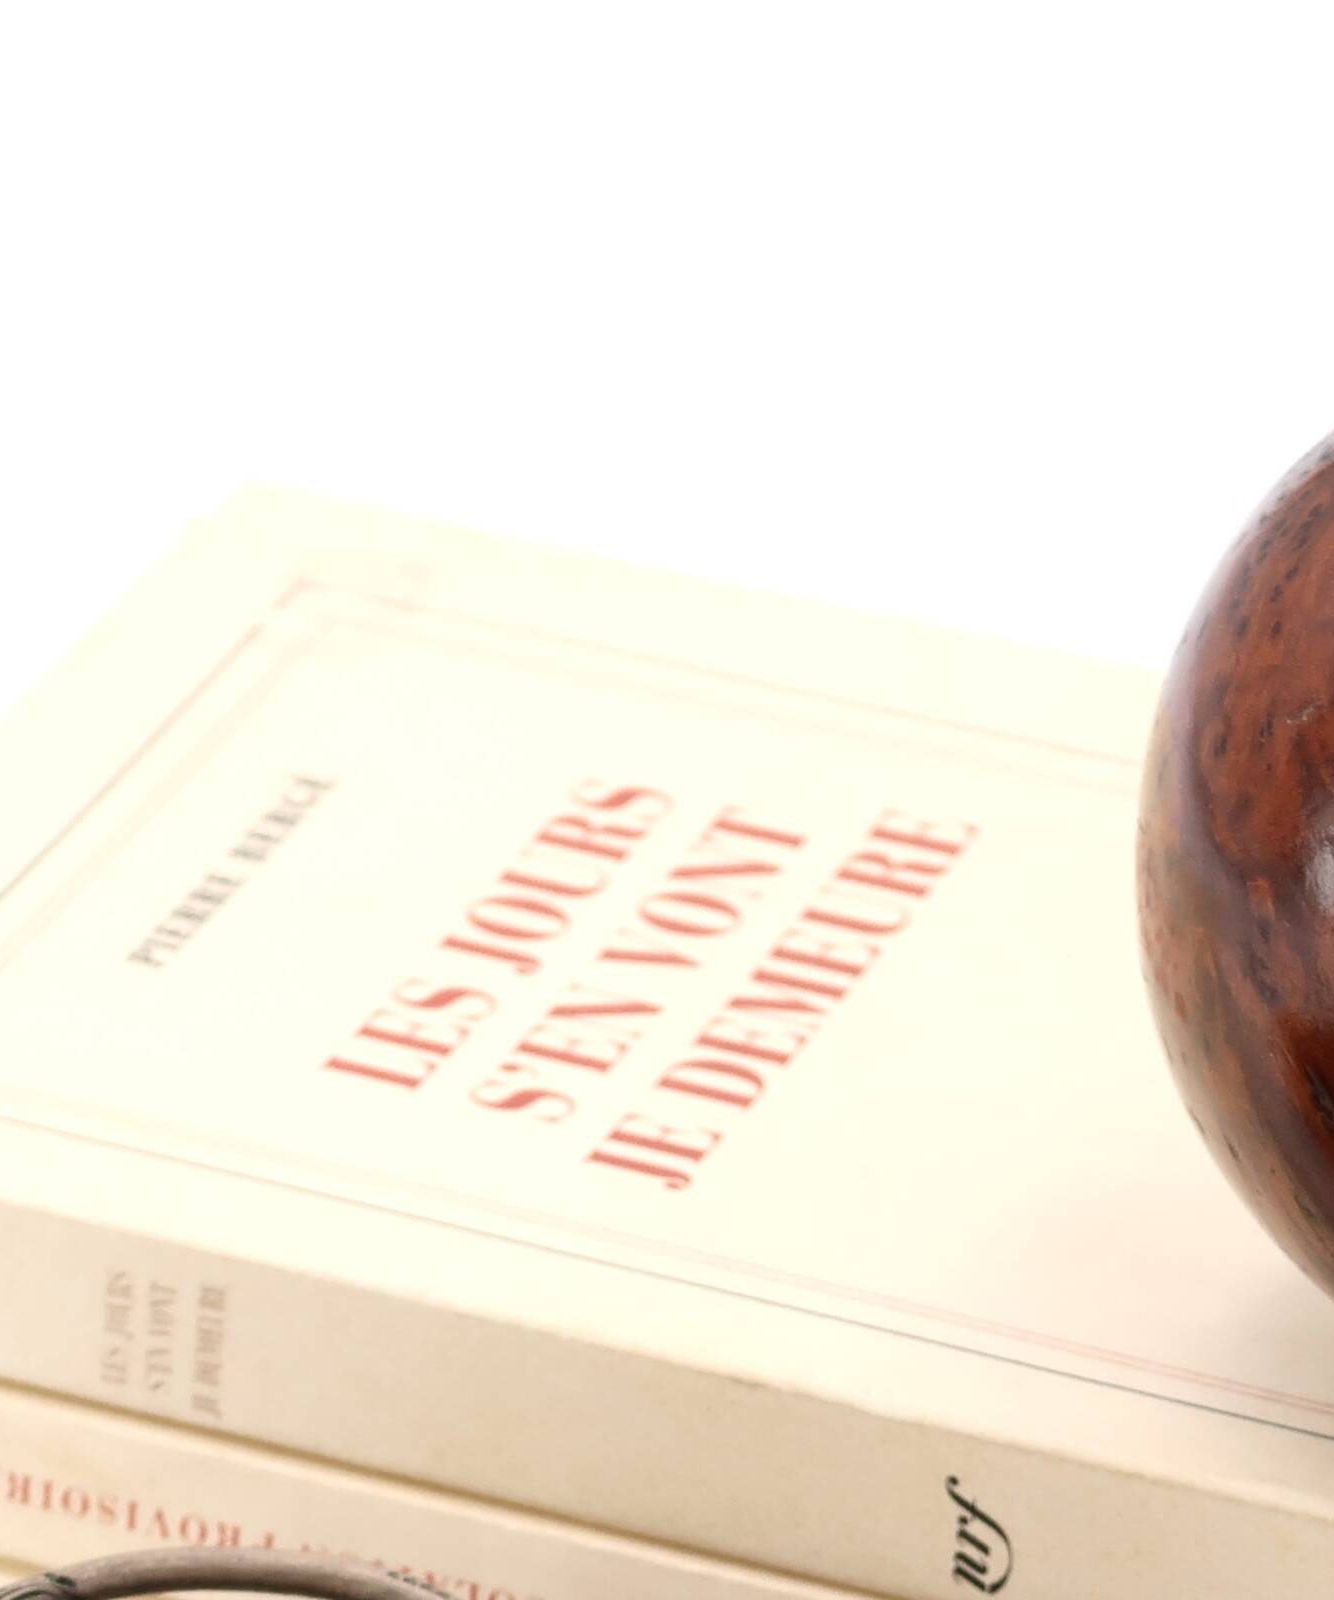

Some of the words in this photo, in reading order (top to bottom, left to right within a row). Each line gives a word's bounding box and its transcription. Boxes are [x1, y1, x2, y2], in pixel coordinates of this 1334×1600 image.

[322, 976, 499, 1092] LES
[439, 777, 675, 976] JOURS
[467, 983, 665, 1125] S'EN
[595, 804, 807, 970] VONT
[583, 1111, 723, 1191] JE
[655, 806, 982, 1110] DEMEURE
